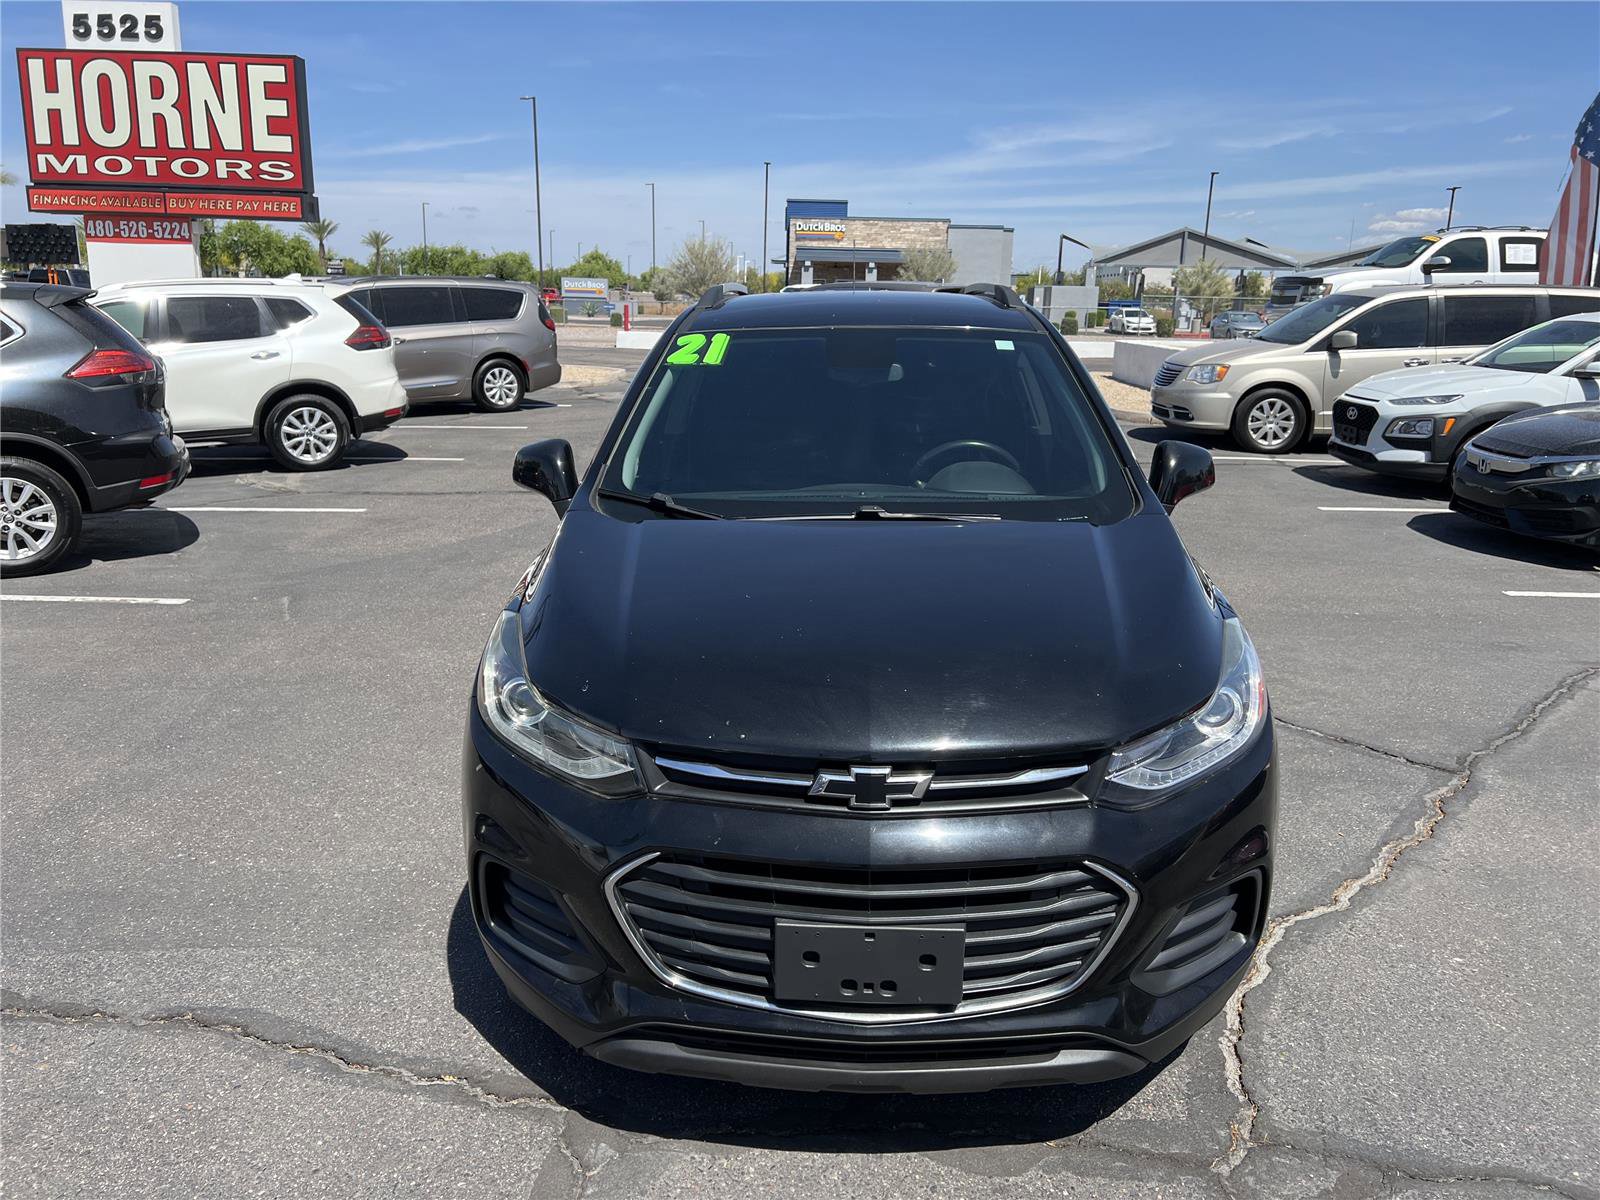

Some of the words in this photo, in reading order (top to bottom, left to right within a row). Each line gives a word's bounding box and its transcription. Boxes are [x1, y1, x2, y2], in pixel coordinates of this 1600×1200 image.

[72, 13, 164, 41] 5525
[26, 58, 293, 152] HORNE
[36, 153, 295, 181] MOTORS
[33, 194, 97, 206] FINANCING
[100, 197, 161, 208] AVAILABLE
[169, 198, 195, 208] BUY
[199, 200, 232, 210] HERE
[236, 201, 259, 211] PAY
[263, 202, 297, 212] HERE
[86, 220, 190, 239] 480-526-5224
[666, 333, 730, 365] 21
